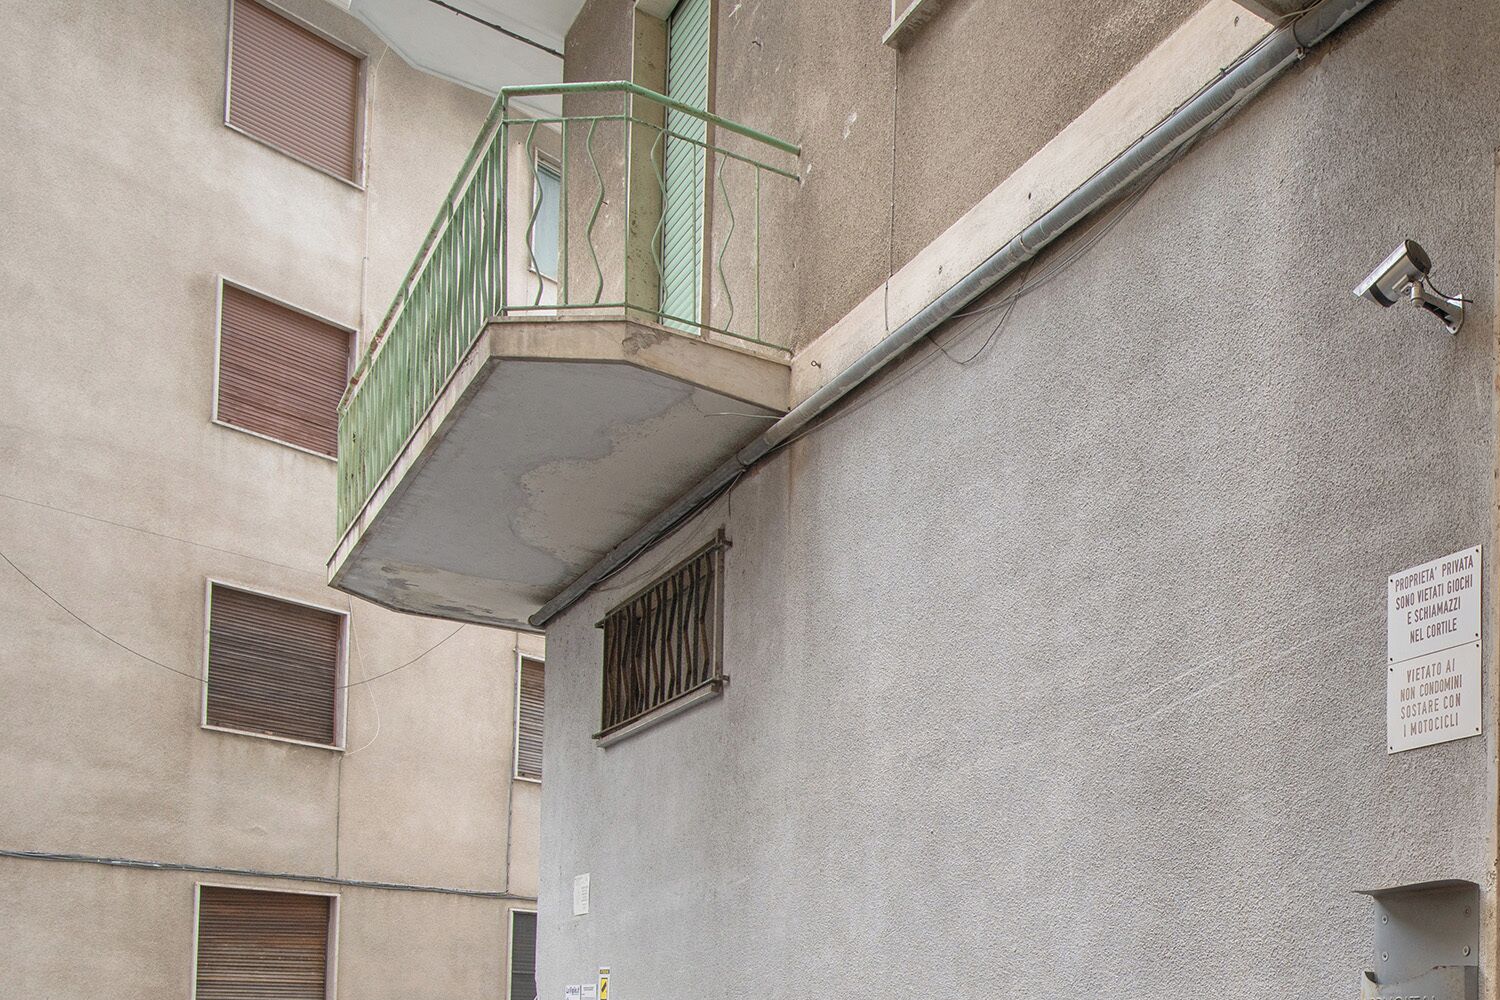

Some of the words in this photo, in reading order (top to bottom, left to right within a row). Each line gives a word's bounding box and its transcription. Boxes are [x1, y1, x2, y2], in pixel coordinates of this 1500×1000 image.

[1441, 555, 1473, 578] PRIVATA
[1395, 592, 1415, 611] SONO
[1417, 583, 1444, 607] VIETATI
[1447, 574, 1473, 594] GIOCHI
[1407, 611, 1412, 625] E
[1414, 596, 1461, 623] SCHIAMAZZI
[1409, 628, 1424, 644] NEL
[1426, 618, 1457, 640] CORTILE
[1406, 662, 1442, 683] VIETATO
[1445, 658, 1455, 674] AI
[1400, 686, 1416, 702] NON
[1419, 674, 1462, 697] CONDOMINI
[1400, 697, 1440, 719] SOSTARE
[1443, 693, 1461, 709] CON
[1410, 713, 1458, 736] MOTOCICLI
